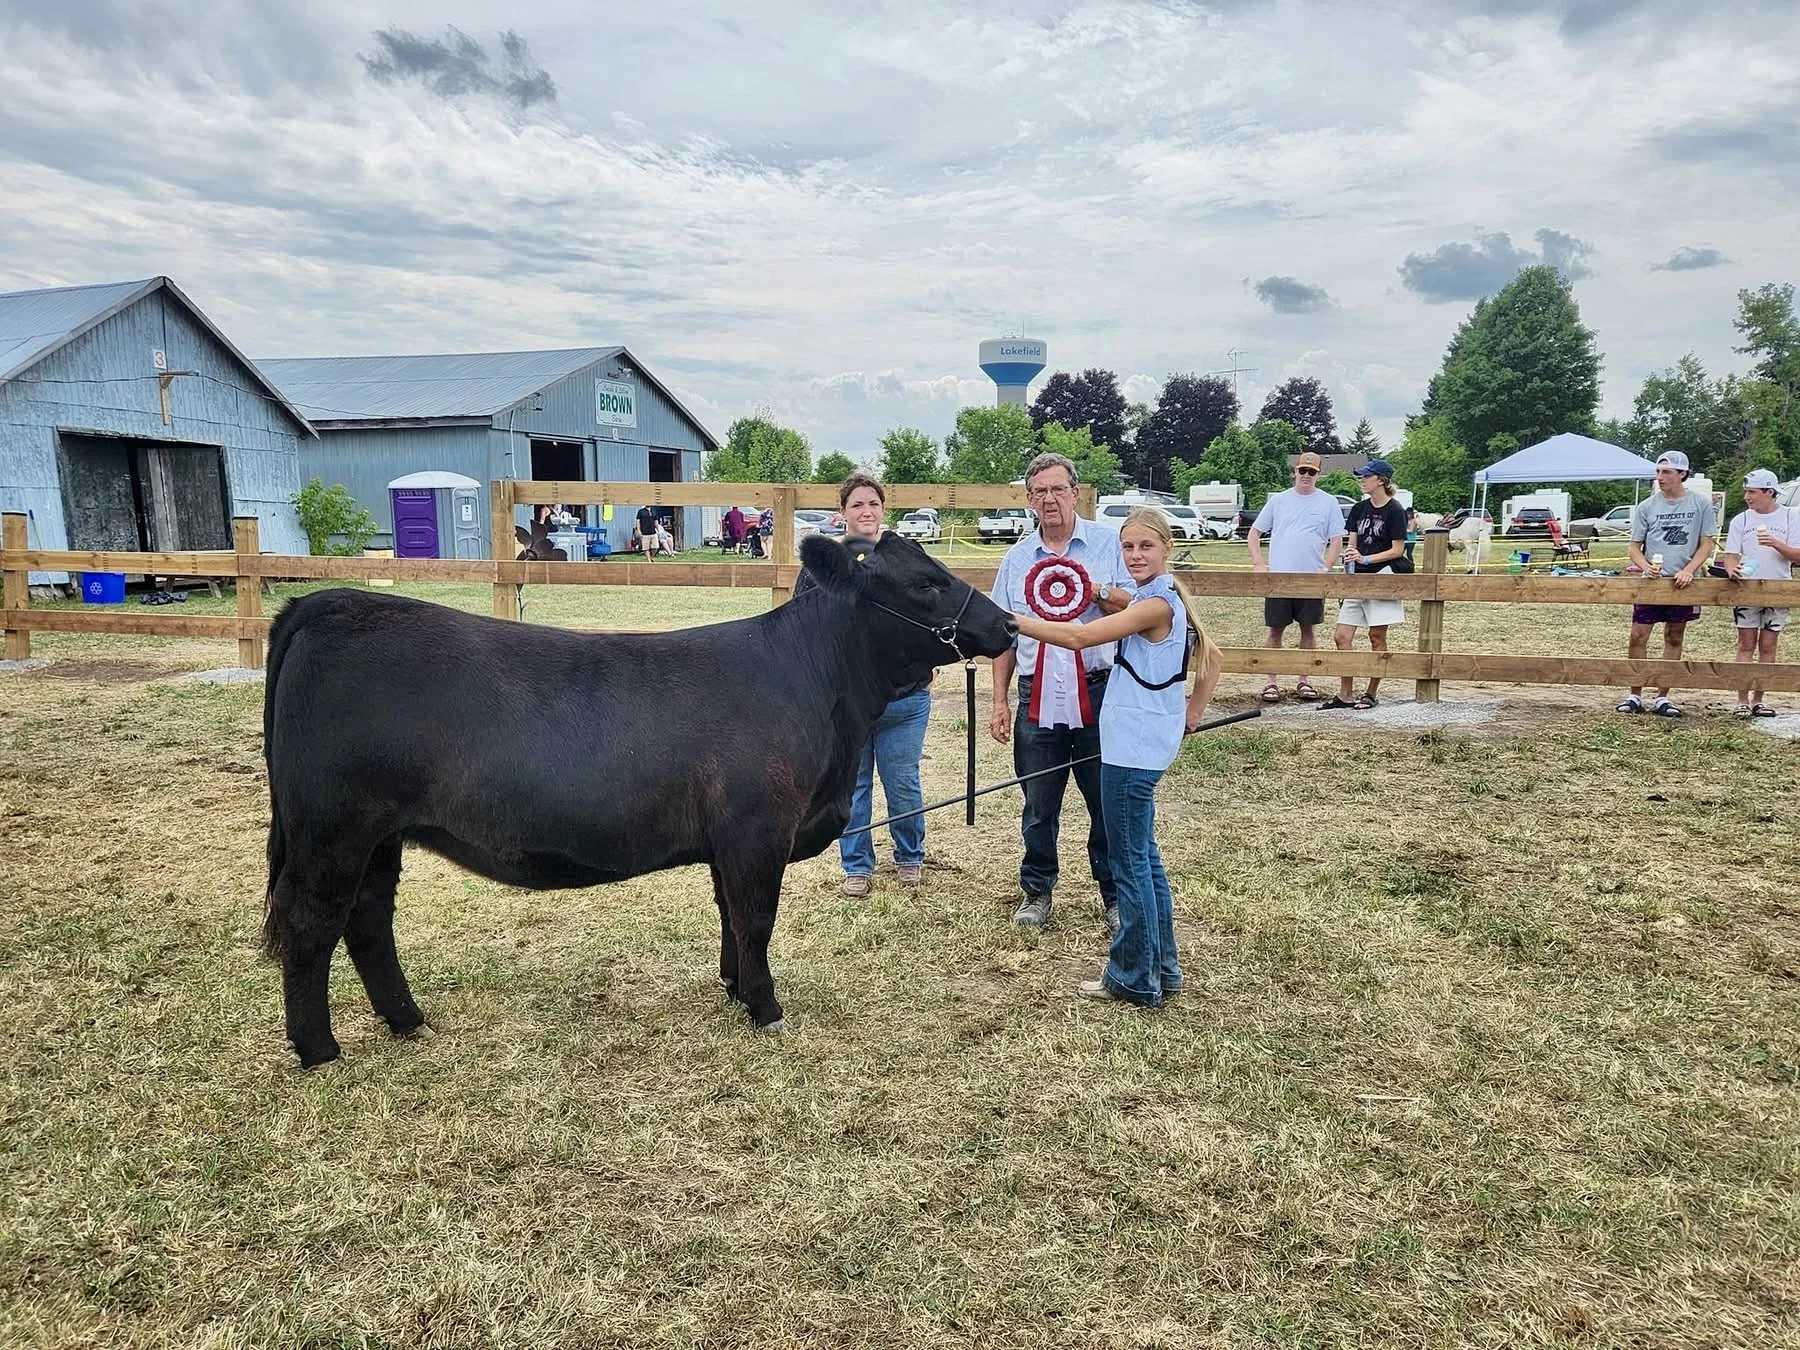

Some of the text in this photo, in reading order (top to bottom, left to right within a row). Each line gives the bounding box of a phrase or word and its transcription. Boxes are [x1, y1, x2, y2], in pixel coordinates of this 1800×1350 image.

[1000, 346, 1041, 356] Lakefield
[155, 351, 164, 366] 3
[600, 392, 632, 415] BROWN
[1656, 512, 1685, 520] PROPERTY
